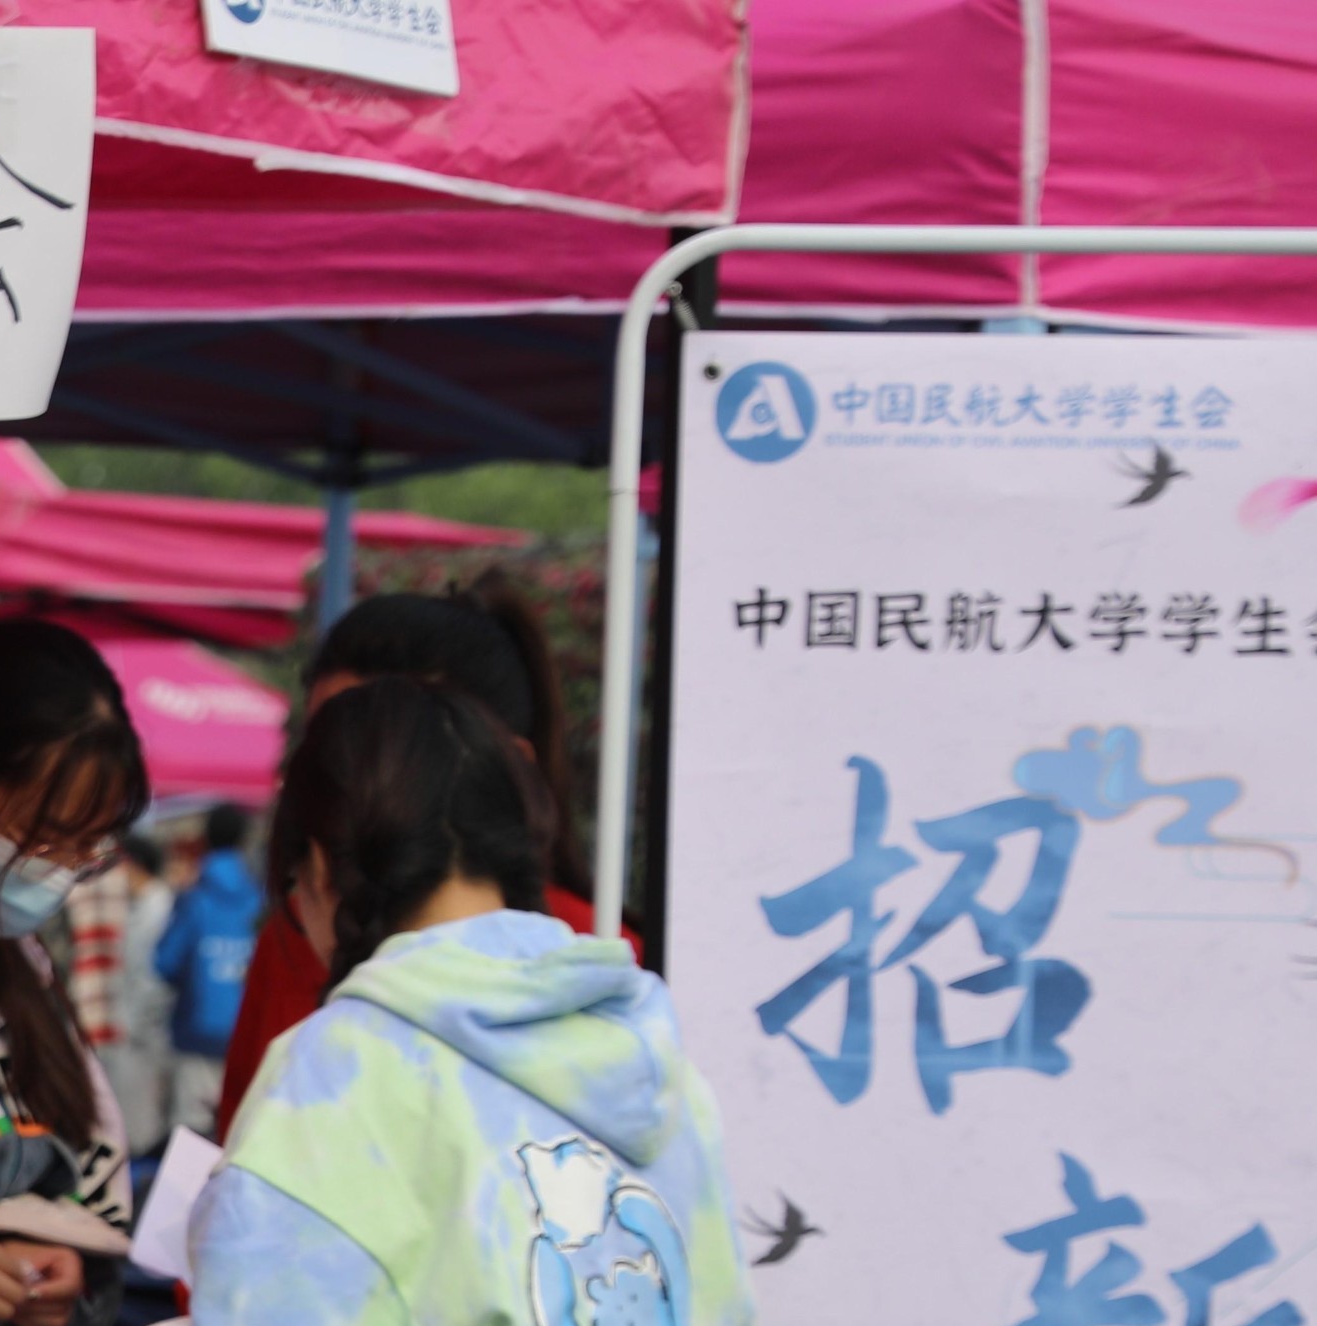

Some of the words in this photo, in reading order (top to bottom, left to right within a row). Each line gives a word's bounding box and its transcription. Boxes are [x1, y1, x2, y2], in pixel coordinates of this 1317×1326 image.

[831, 382, 1234, 428] 中国民航大学学生会
[734, 587, 1317, 655] 中国民航大学学生
[755, 755, 1093, 1116] 招
